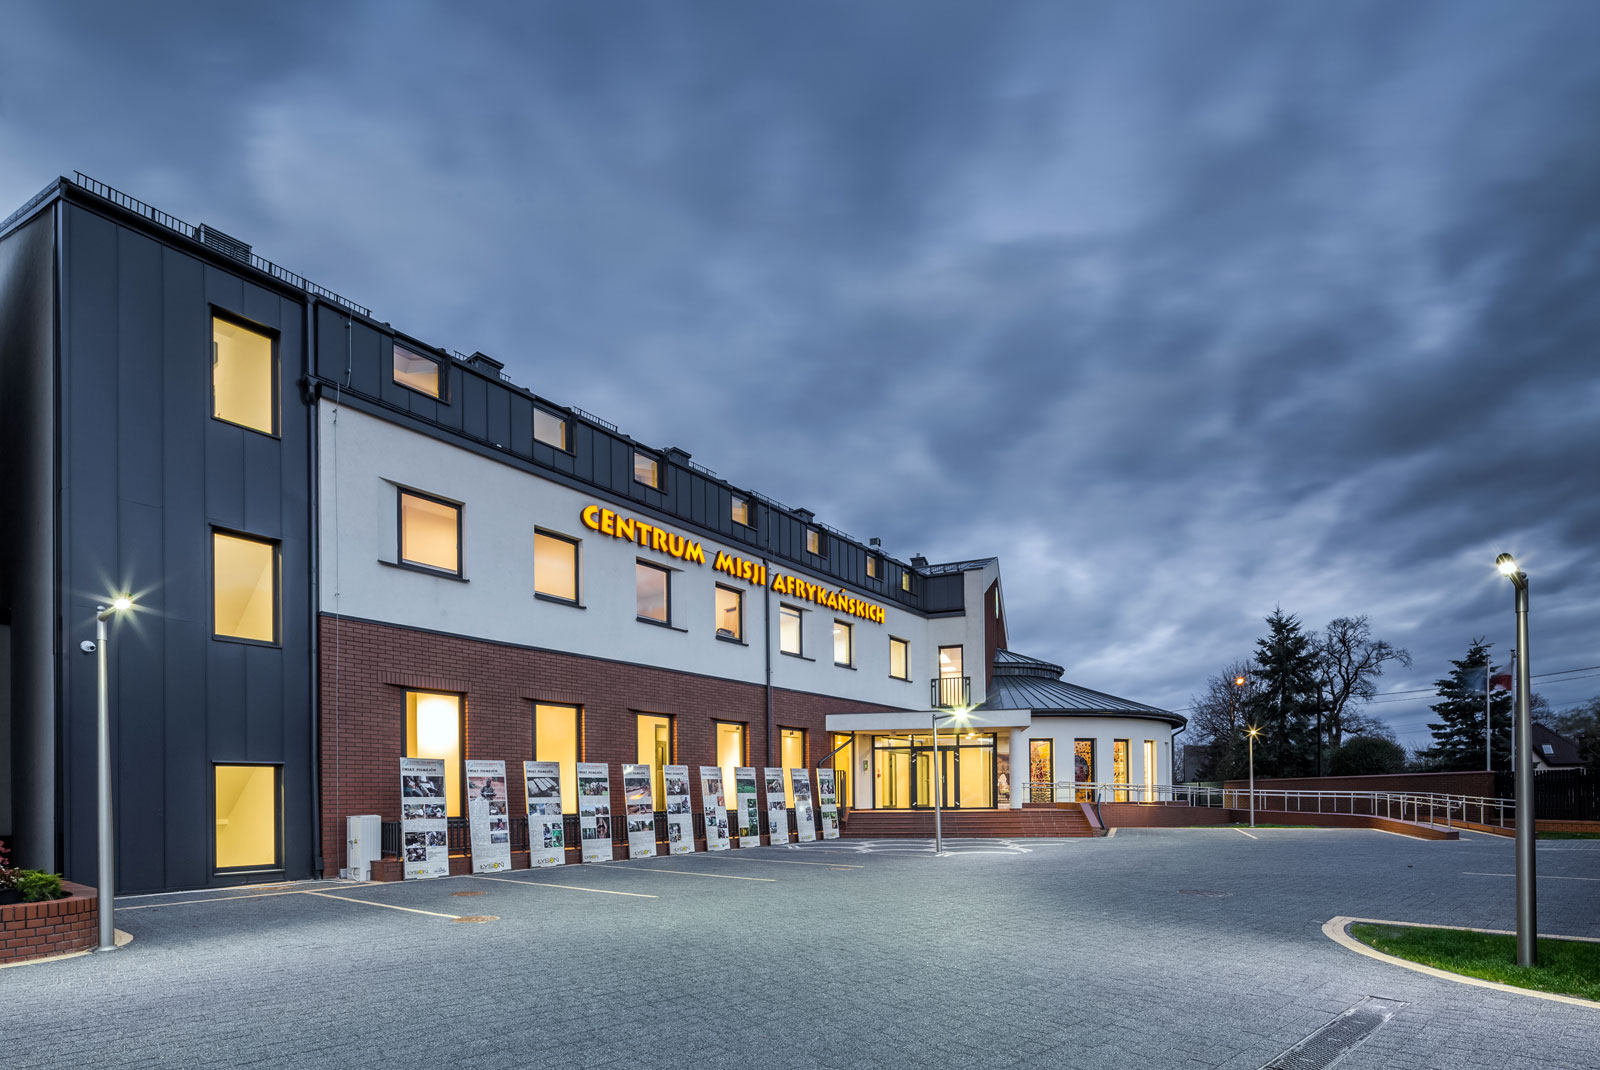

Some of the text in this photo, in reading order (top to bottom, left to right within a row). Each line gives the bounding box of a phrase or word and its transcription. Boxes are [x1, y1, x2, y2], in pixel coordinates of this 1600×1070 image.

[580, 505, 885, 625] CENTRUM MISJI AFRYKAŃSKICH
